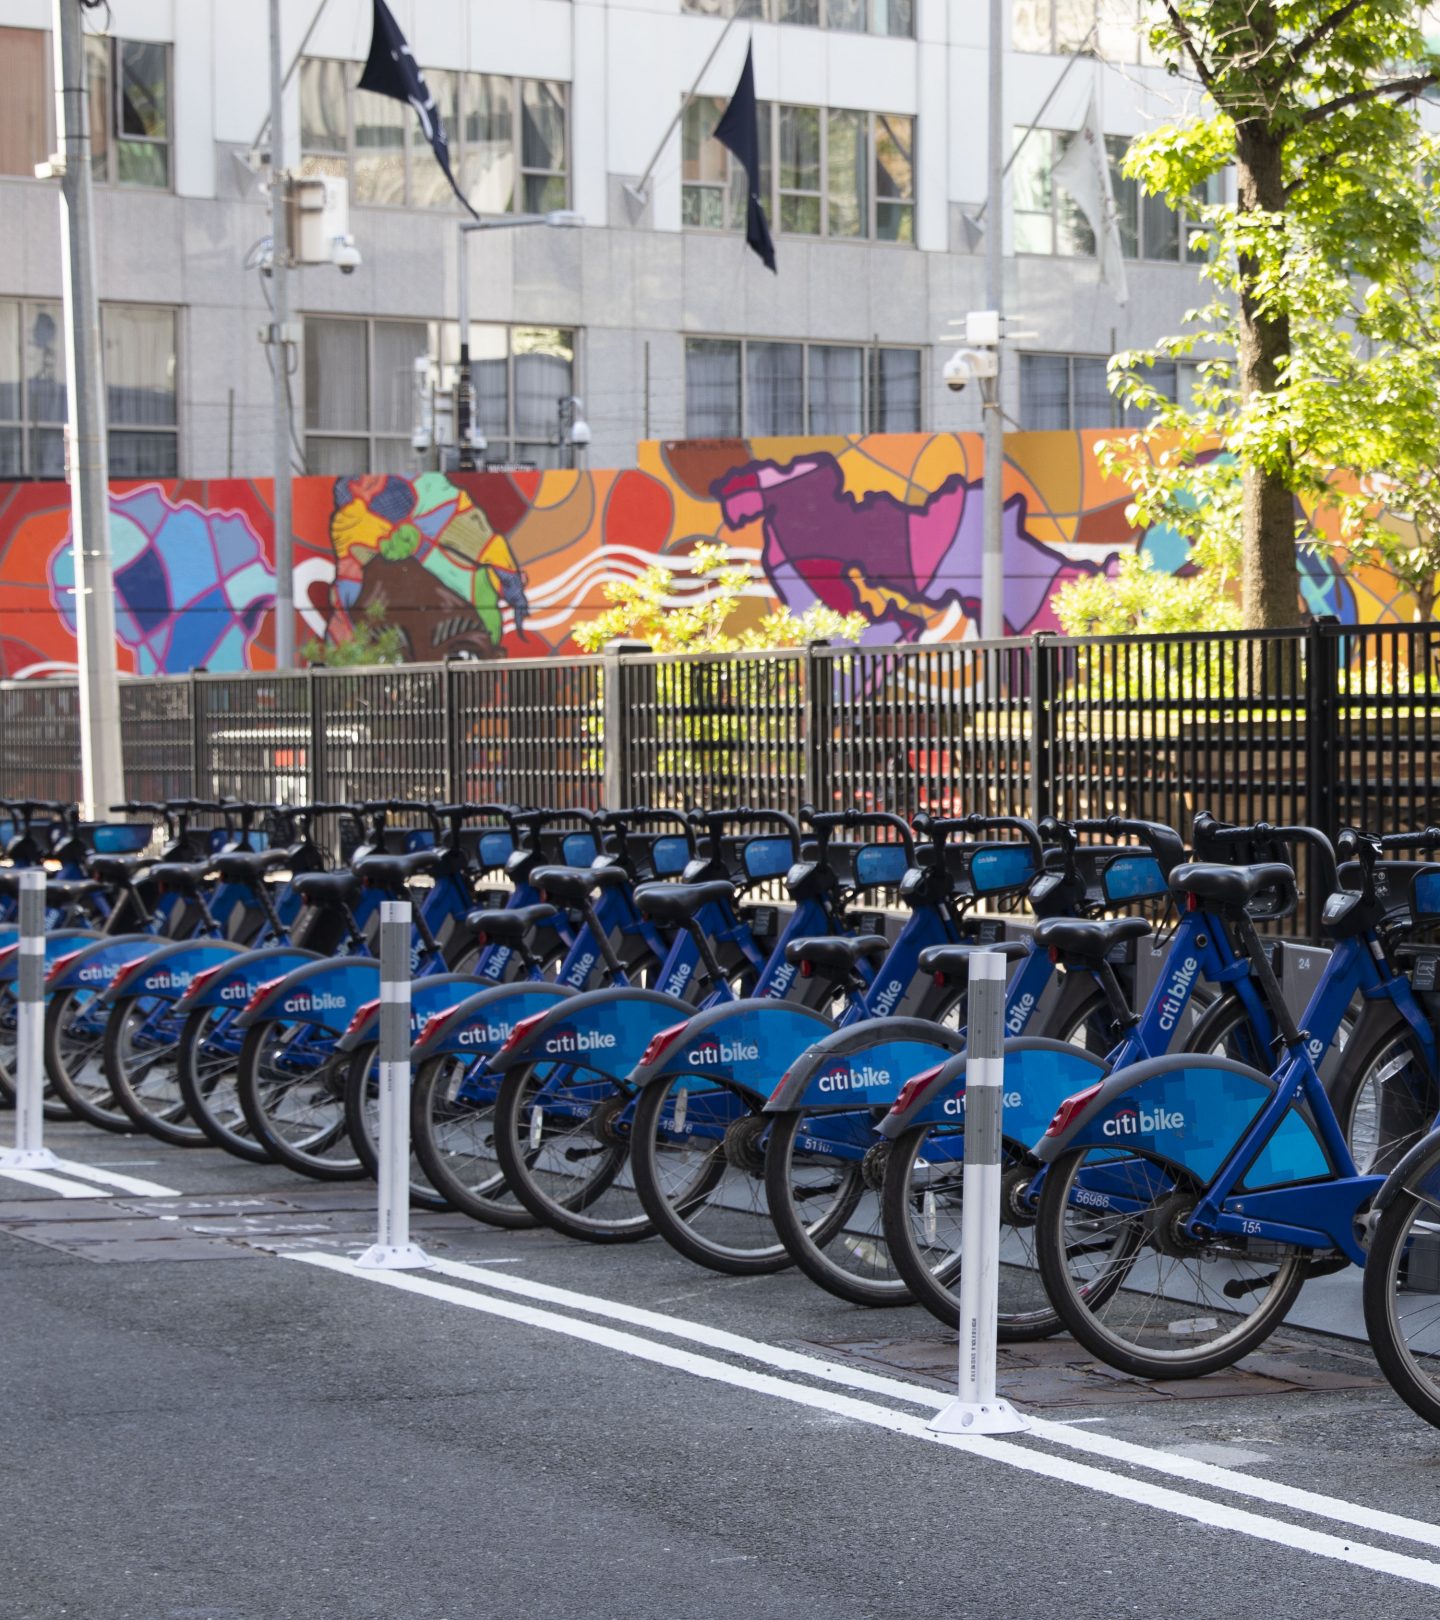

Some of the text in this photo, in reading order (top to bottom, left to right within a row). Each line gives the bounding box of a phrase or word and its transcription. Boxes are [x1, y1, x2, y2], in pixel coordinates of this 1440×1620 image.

[567, 953, 594, 987] bike
[1299, 958, 1310, 969] 24
[665, 963, 691, 998] bike
[769, 962, 795, 992] bik
[284, 993, 346, 1012] citi bike
[872, 980, 902, 1017] bike
[1159, 957, 1198, 1031] citi bike
[1006, 992, 1035, 1036] bike
[459, 1024, 486, 1044] citi
[546, 1031, 616, 1053] citi bike
[689, 1042, 759, 1065] citi bike
[819, 1067, 890, 1092] citi bike
[1103, 1108, 1184, 1136] citi bike
[1076, 1191, 1110, 1208] 56986
